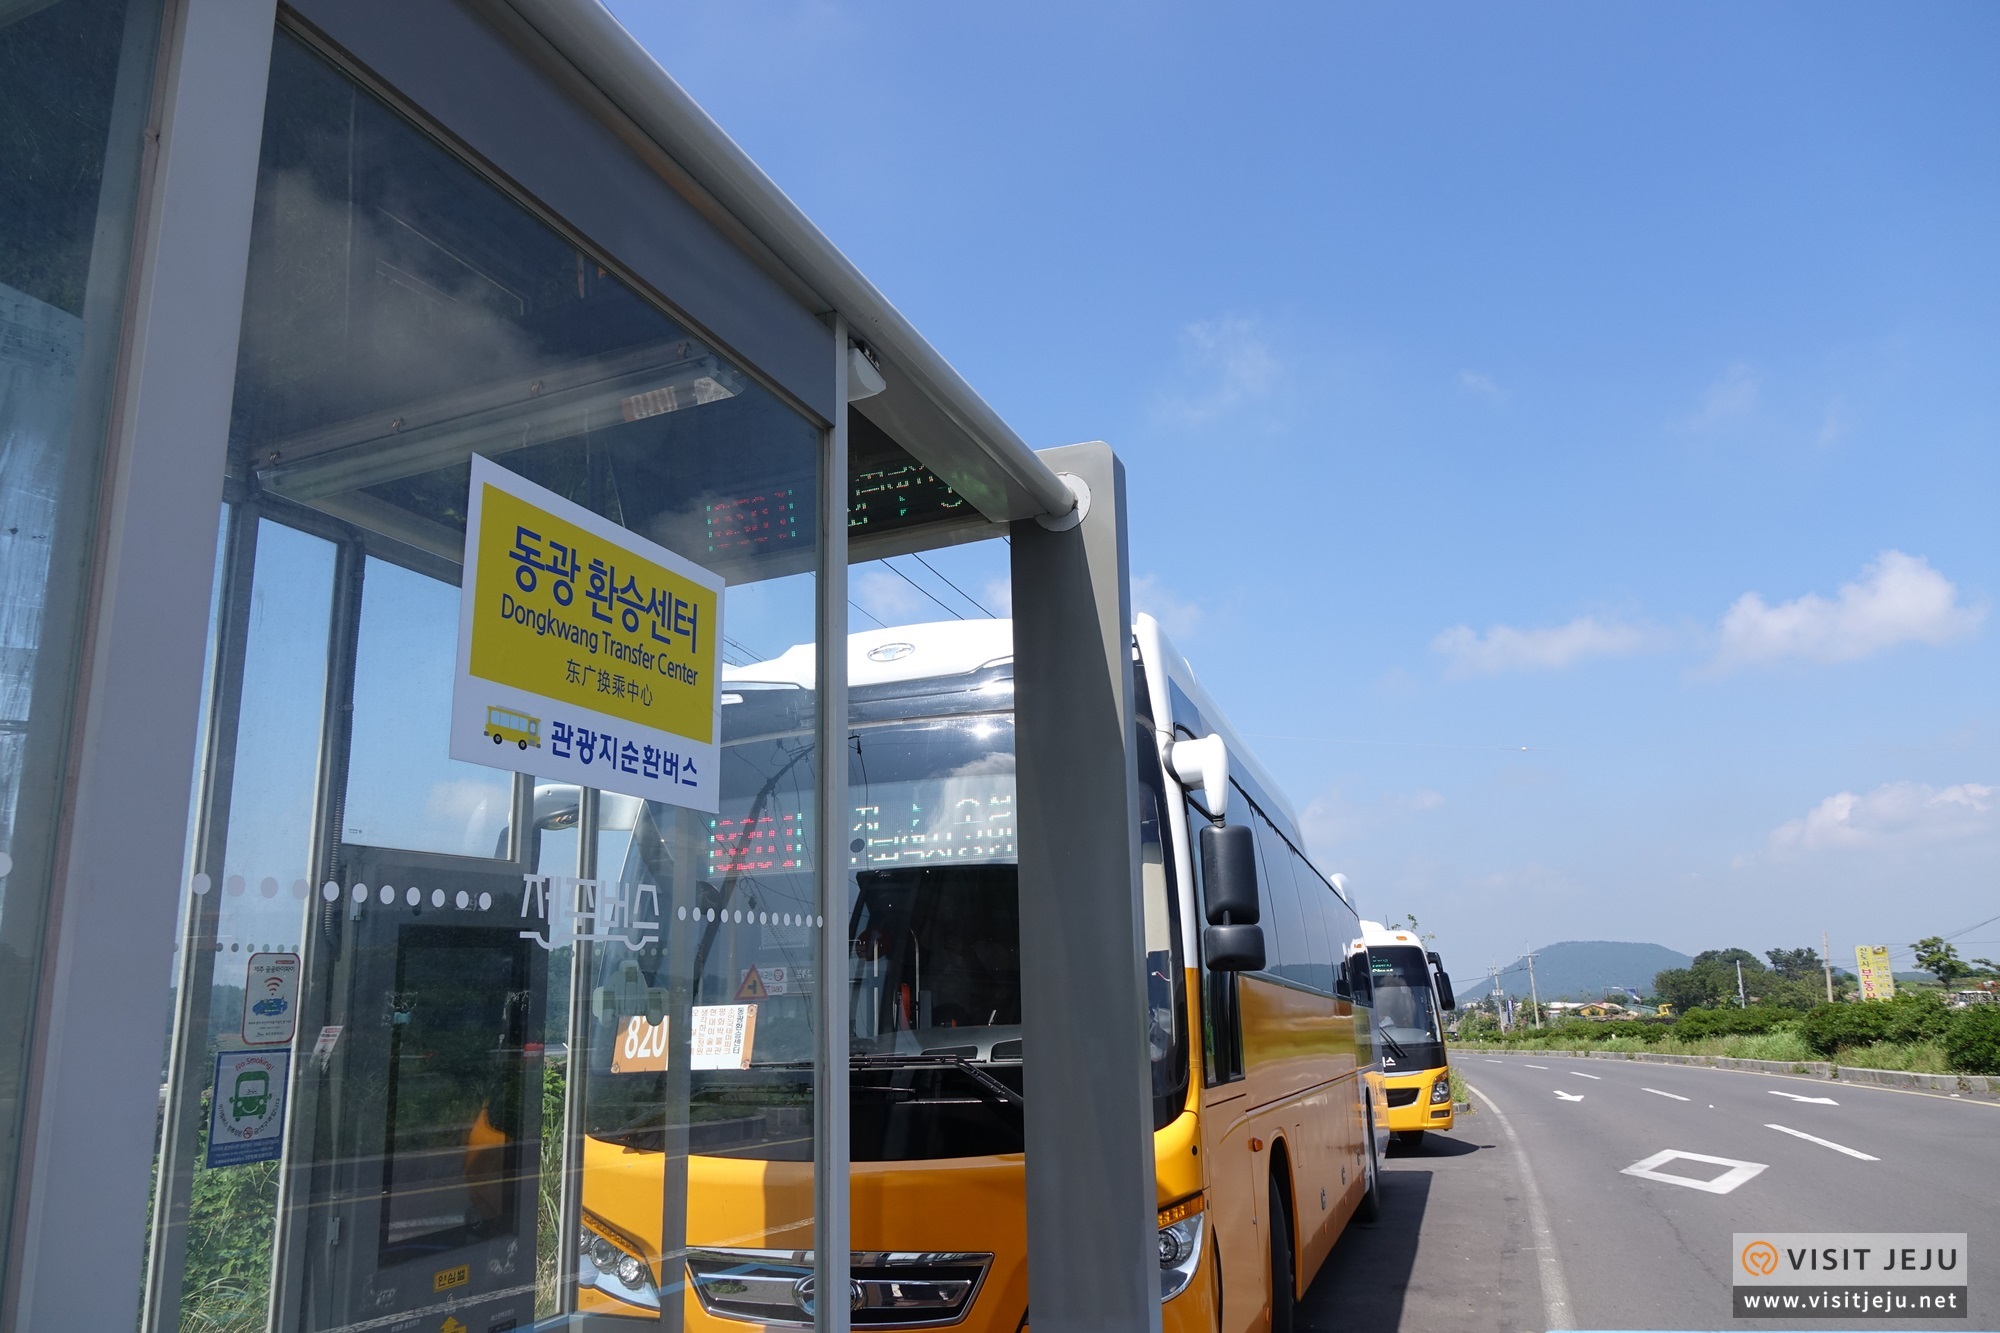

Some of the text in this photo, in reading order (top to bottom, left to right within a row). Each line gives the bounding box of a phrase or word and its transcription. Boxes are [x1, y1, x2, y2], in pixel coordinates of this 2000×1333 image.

[509, 526, 698, 654] 동광 환승센터
[501, 593, 698, 687] Dongkwang Transfer Center
[566, 659, 654, 707] 东广换乘中心
[551, 720, 698, 787] 관광지순환버스
[235, 1056, 275, 1071] No Smoking!
[624, 1015, 667, 1060] 820
